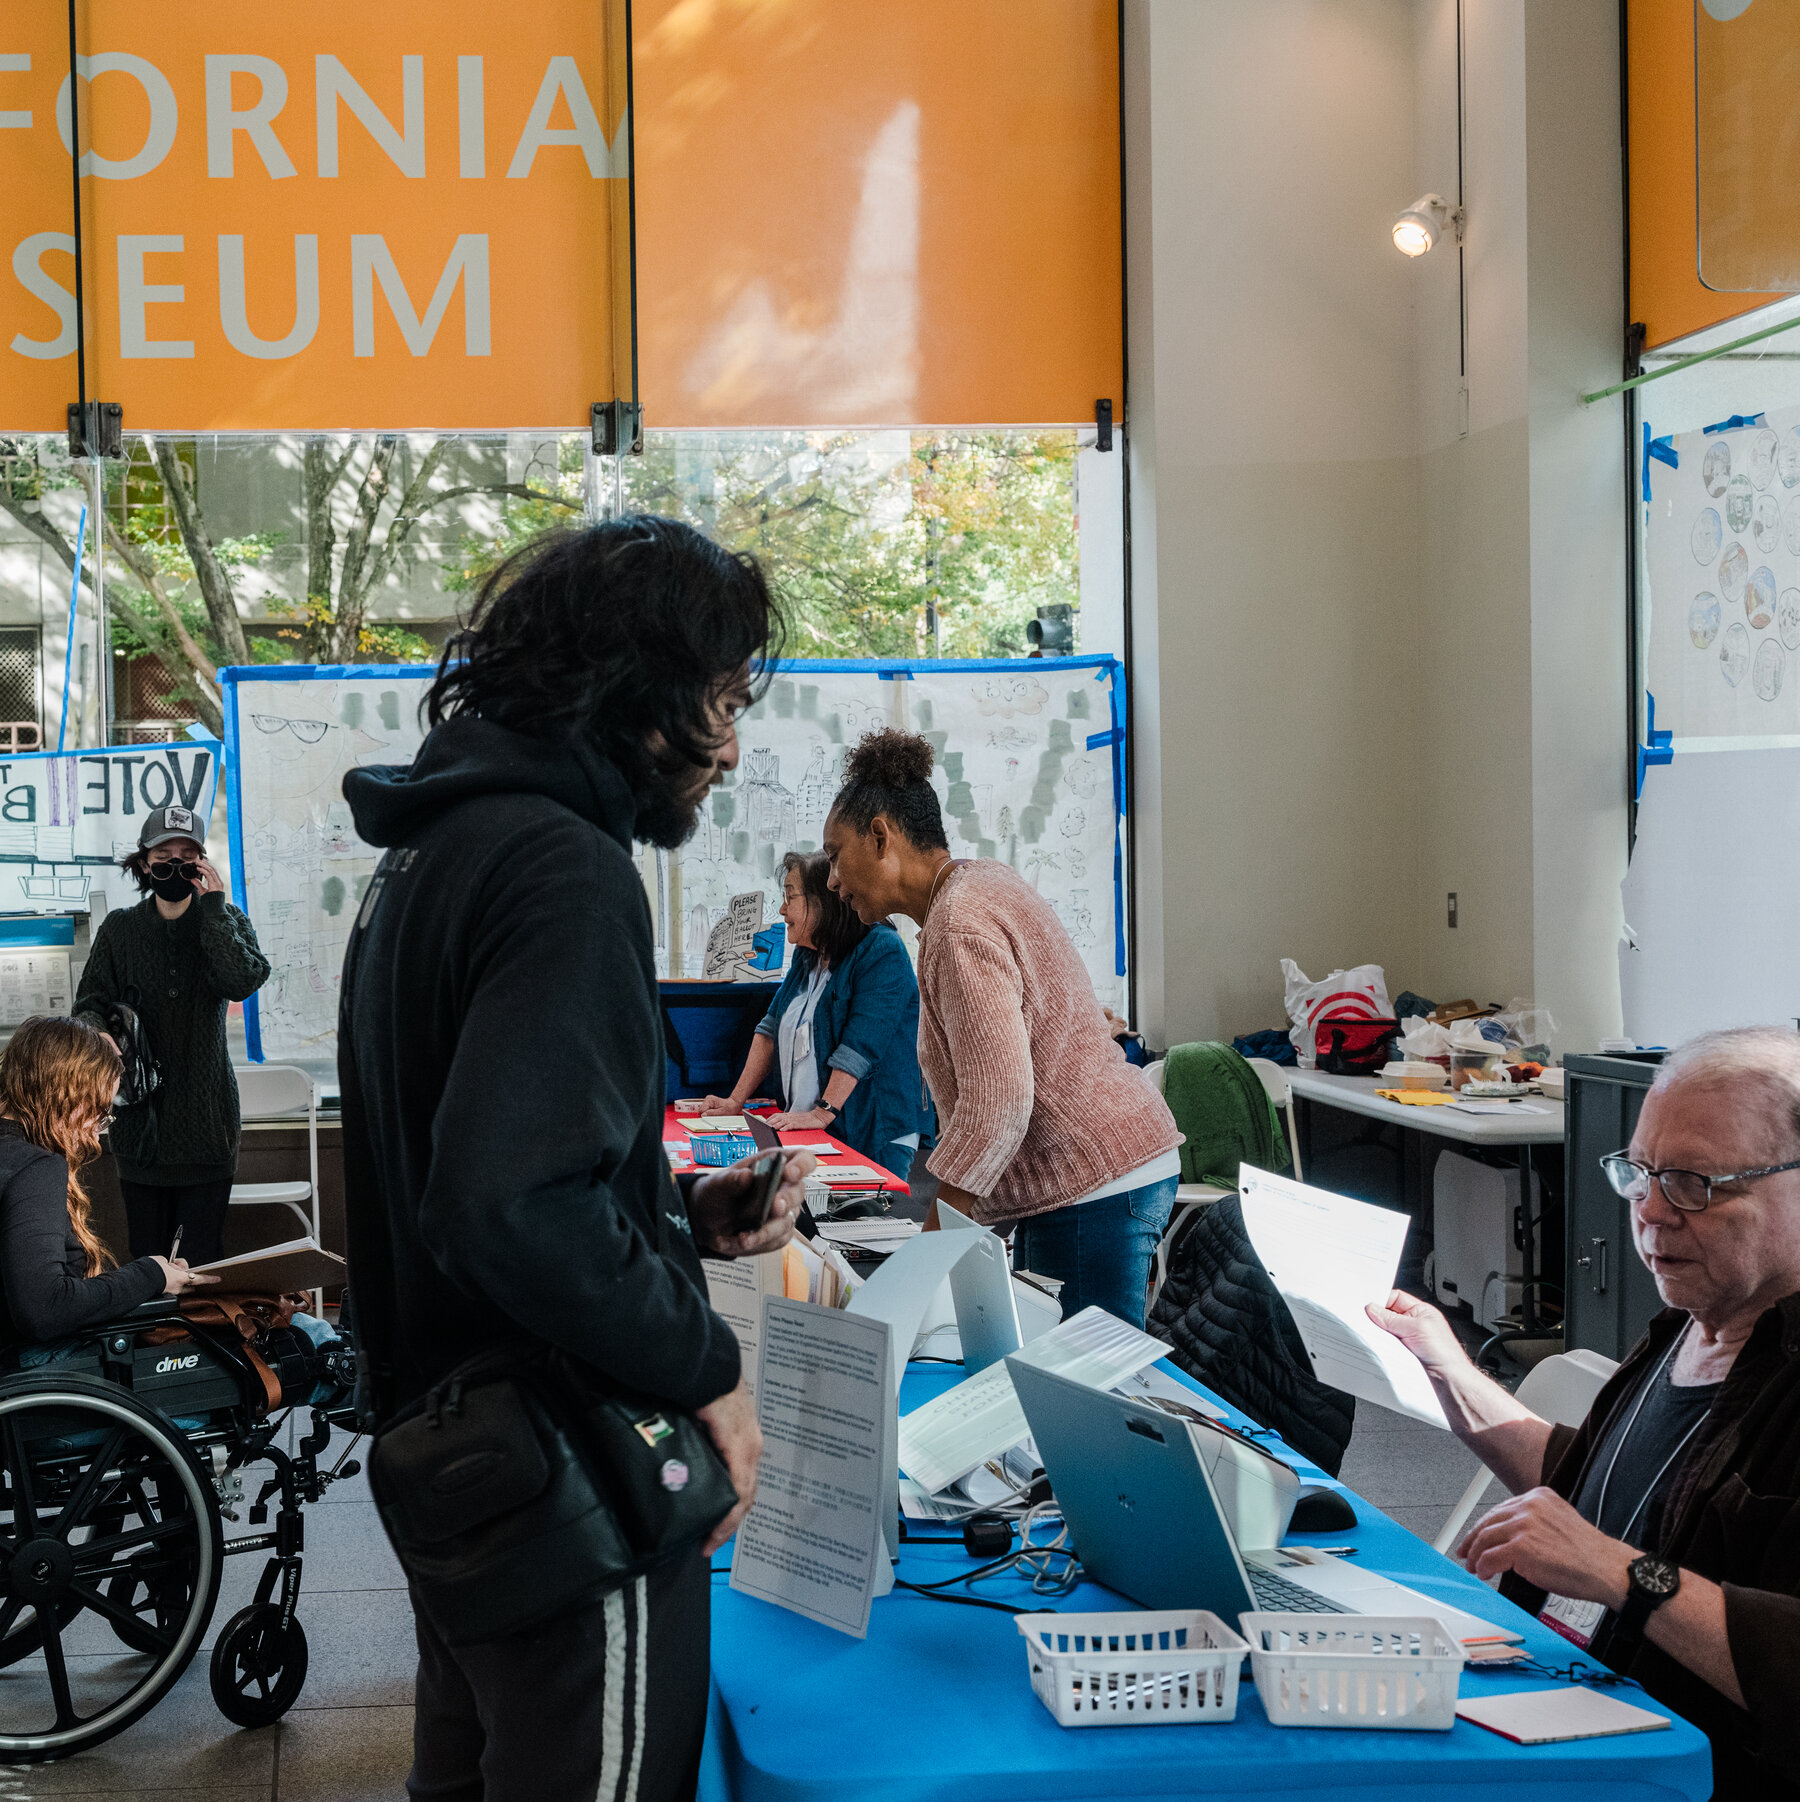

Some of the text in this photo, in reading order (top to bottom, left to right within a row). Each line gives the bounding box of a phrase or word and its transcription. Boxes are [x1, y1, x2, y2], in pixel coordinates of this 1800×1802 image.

[10, 231, 491, 360] SEUM
[733, 894, 758, 911] PLEASE
[736, 917, 752, 926] YOUR
[737, 907, 757, 918] BRING
[735, 923, 756, 935] BALLOT
[155, 1354, 199, 1373] drive
[948, 1378, 1009, 1414] STATIO
[281, 1567, 297, 1631] Viper Plus GT
